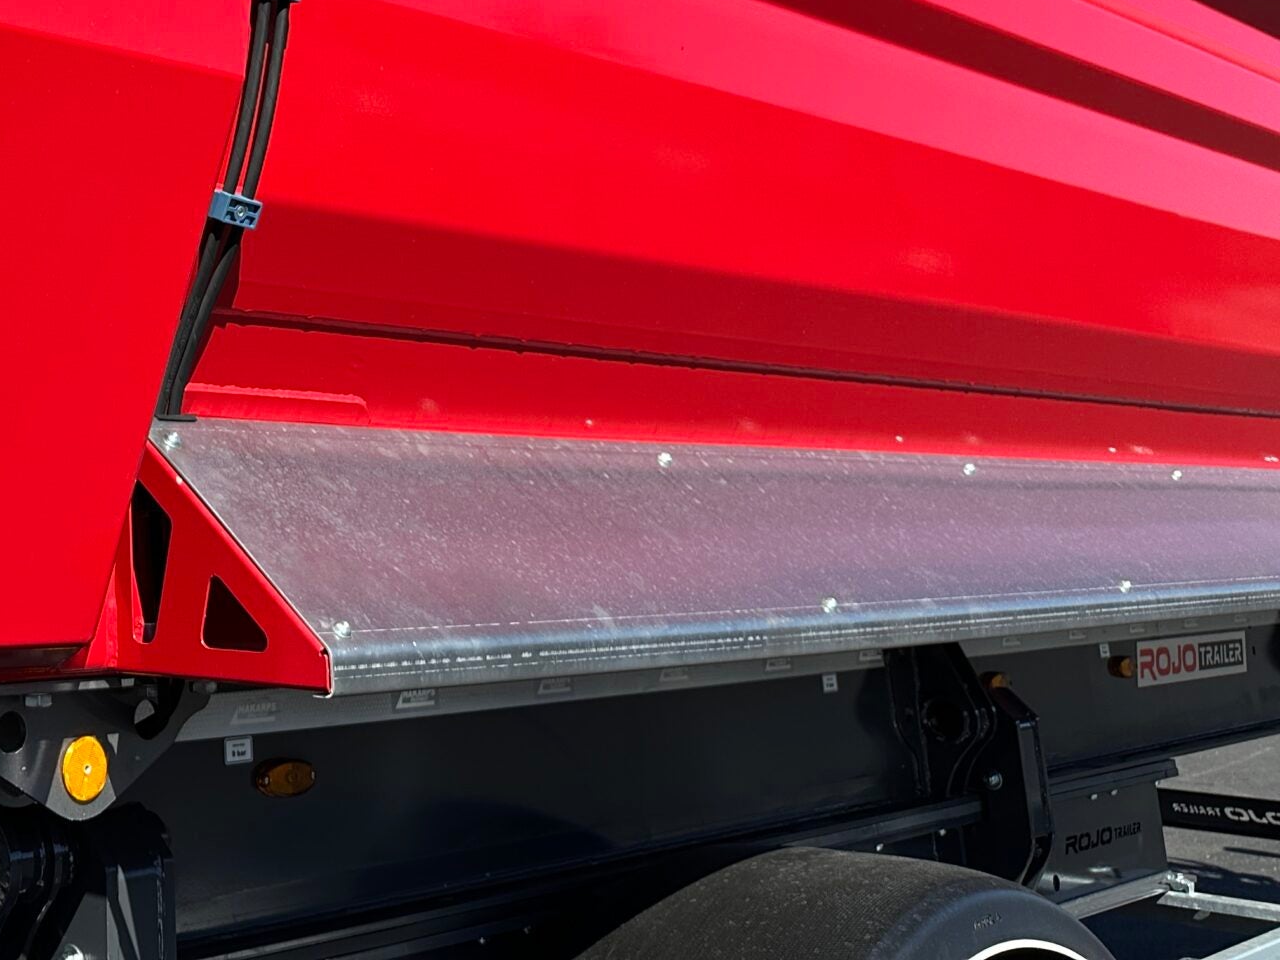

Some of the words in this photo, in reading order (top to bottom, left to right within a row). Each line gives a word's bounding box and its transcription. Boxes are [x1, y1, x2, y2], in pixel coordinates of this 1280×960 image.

[1139, 643, 1197, 681] ROJO
[1200, 642, 1242, 667] TRAILER
[1065, 826, 1113, 855] ROJO
[1114, 822, 1141, 840] TRAILER
